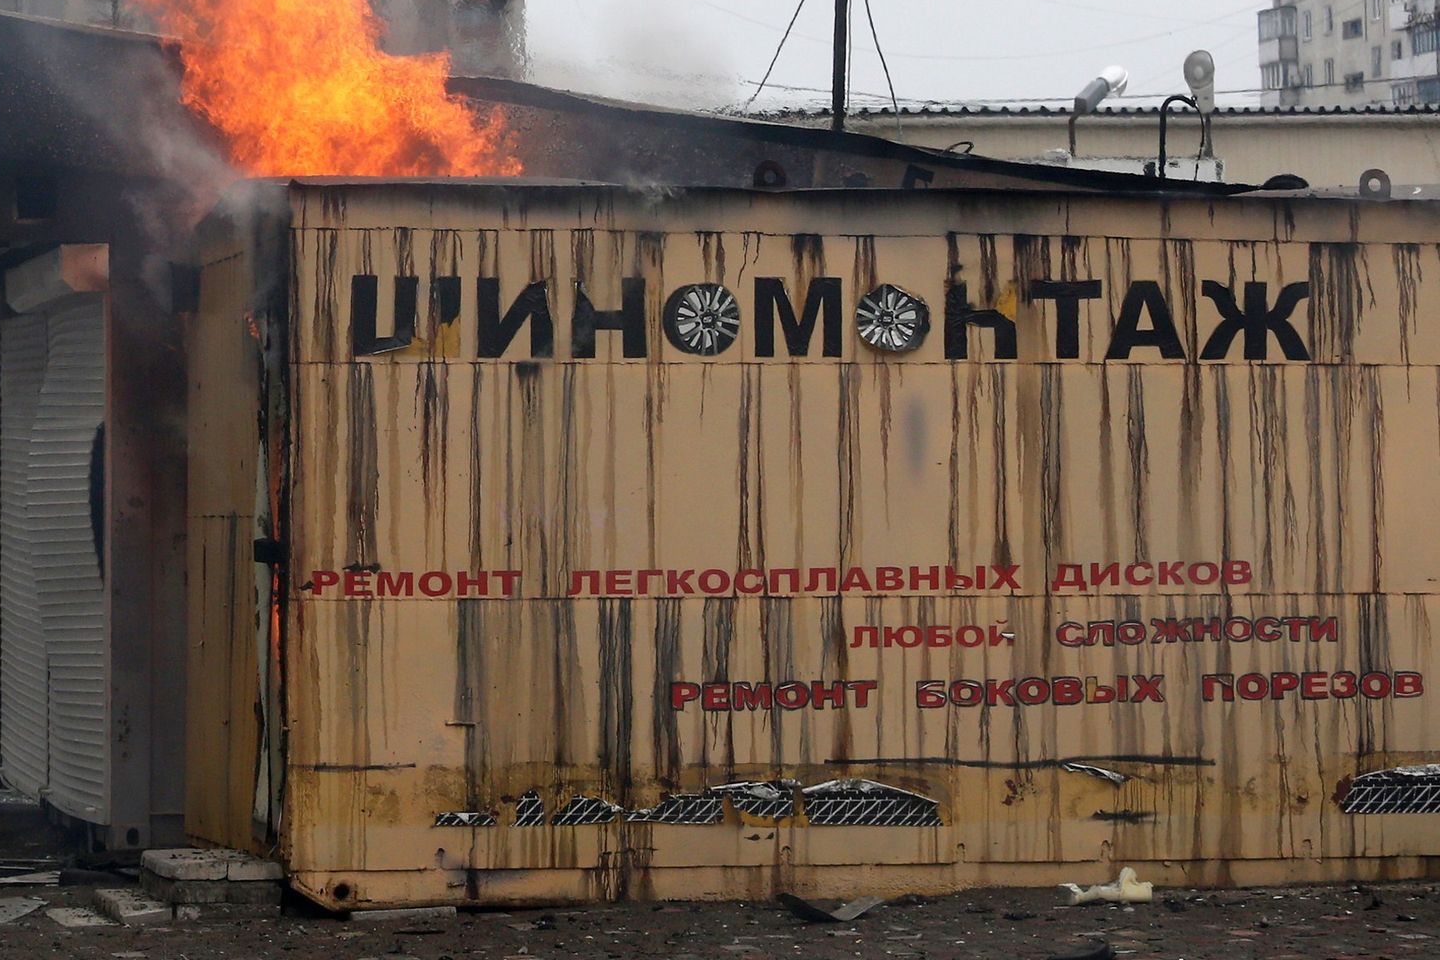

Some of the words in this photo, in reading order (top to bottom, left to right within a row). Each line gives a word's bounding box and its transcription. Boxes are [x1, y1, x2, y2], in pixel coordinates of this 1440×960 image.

[310, 569, 523, 597] РЕМОНТ
[566, 563, 1022, 596] ЛЕГКОСПЛАВНЫХ
[1051, 560, 1254, 593] ДИСКОВ
[849, 620, 1015, 648] ЛЮБОЙ
[1055, 615, 1339, 648] СЛОЖНОСТИ
[670, 679, 878, 713] РЕМОНТ
[916, 674, 1165, 710] БОКОВЫХ
[1202, 671, 1425, 702] ПОРЕЗОВ
